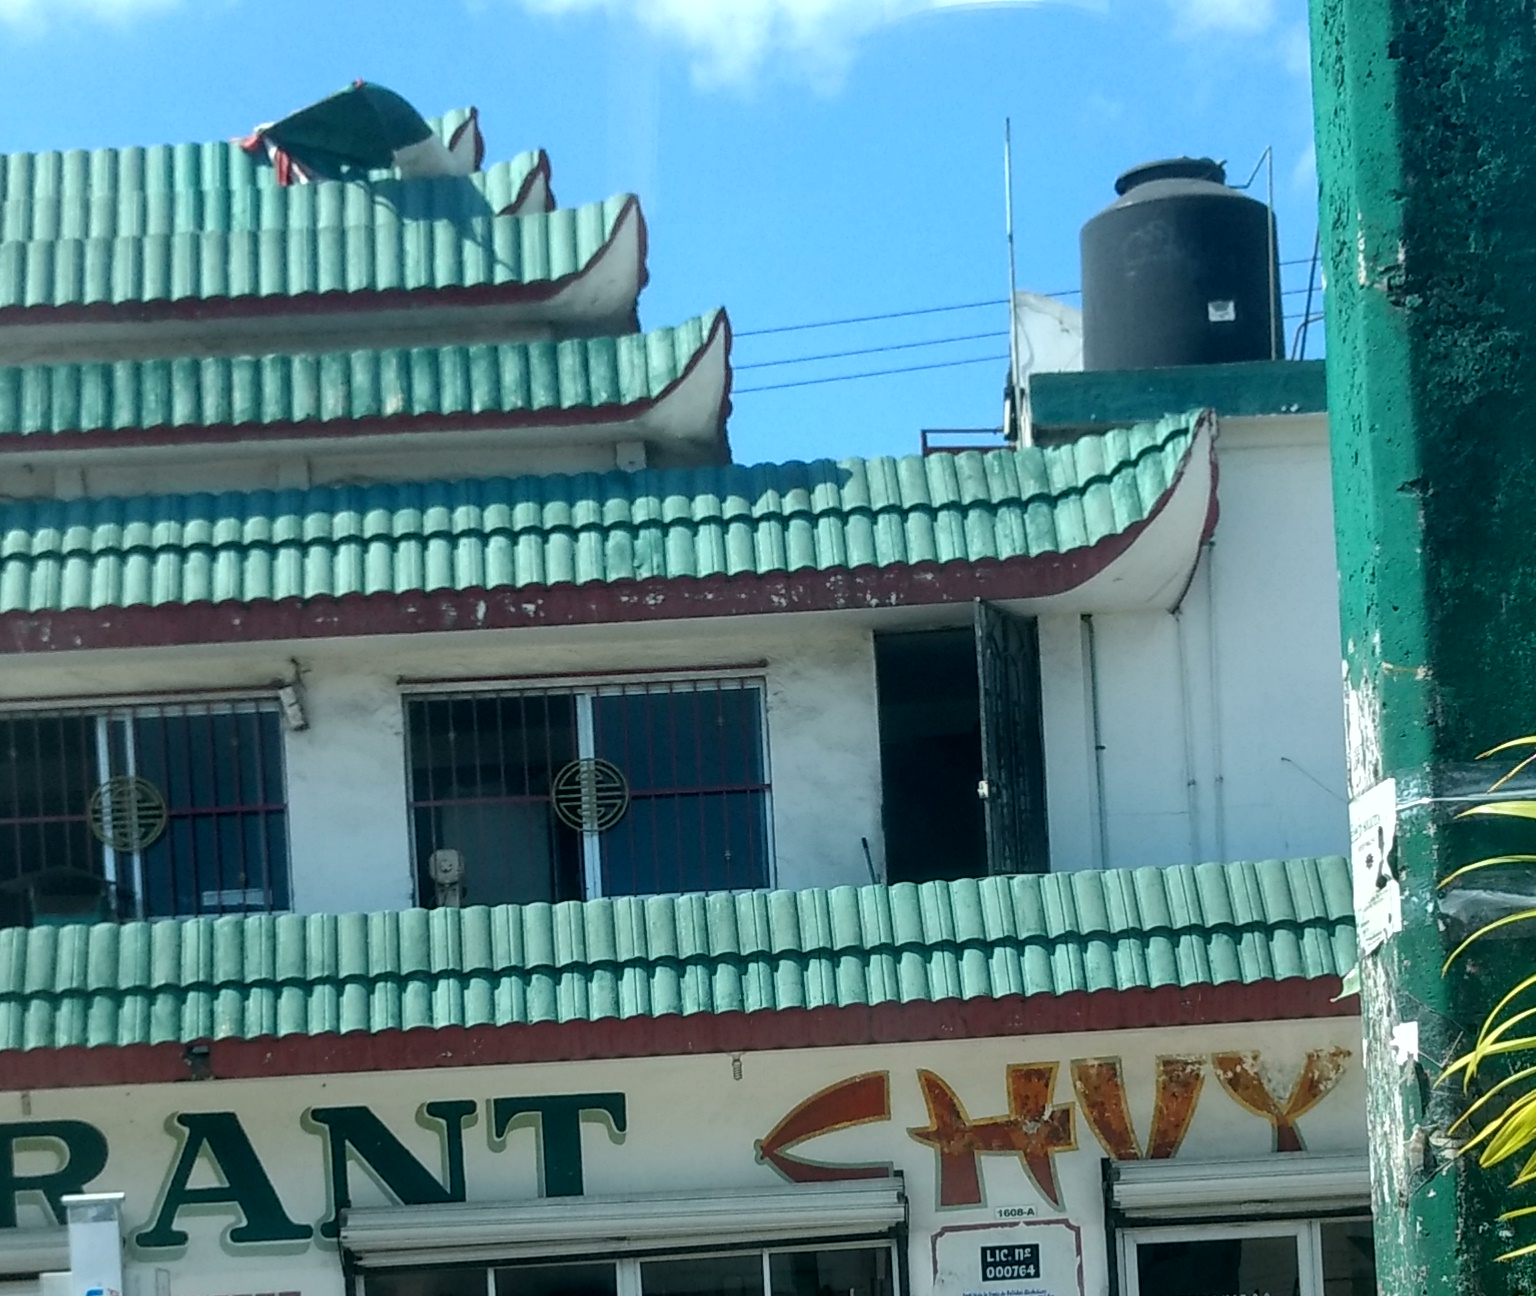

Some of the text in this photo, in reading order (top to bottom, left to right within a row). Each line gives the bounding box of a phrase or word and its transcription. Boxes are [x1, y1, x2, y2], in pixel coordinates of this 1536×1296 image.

[997, 1207, 1035, 1218] 1608-A
[986, 1248, 1013, 1263] LIC.
[985, 1264, 1036, 1279] 000764
